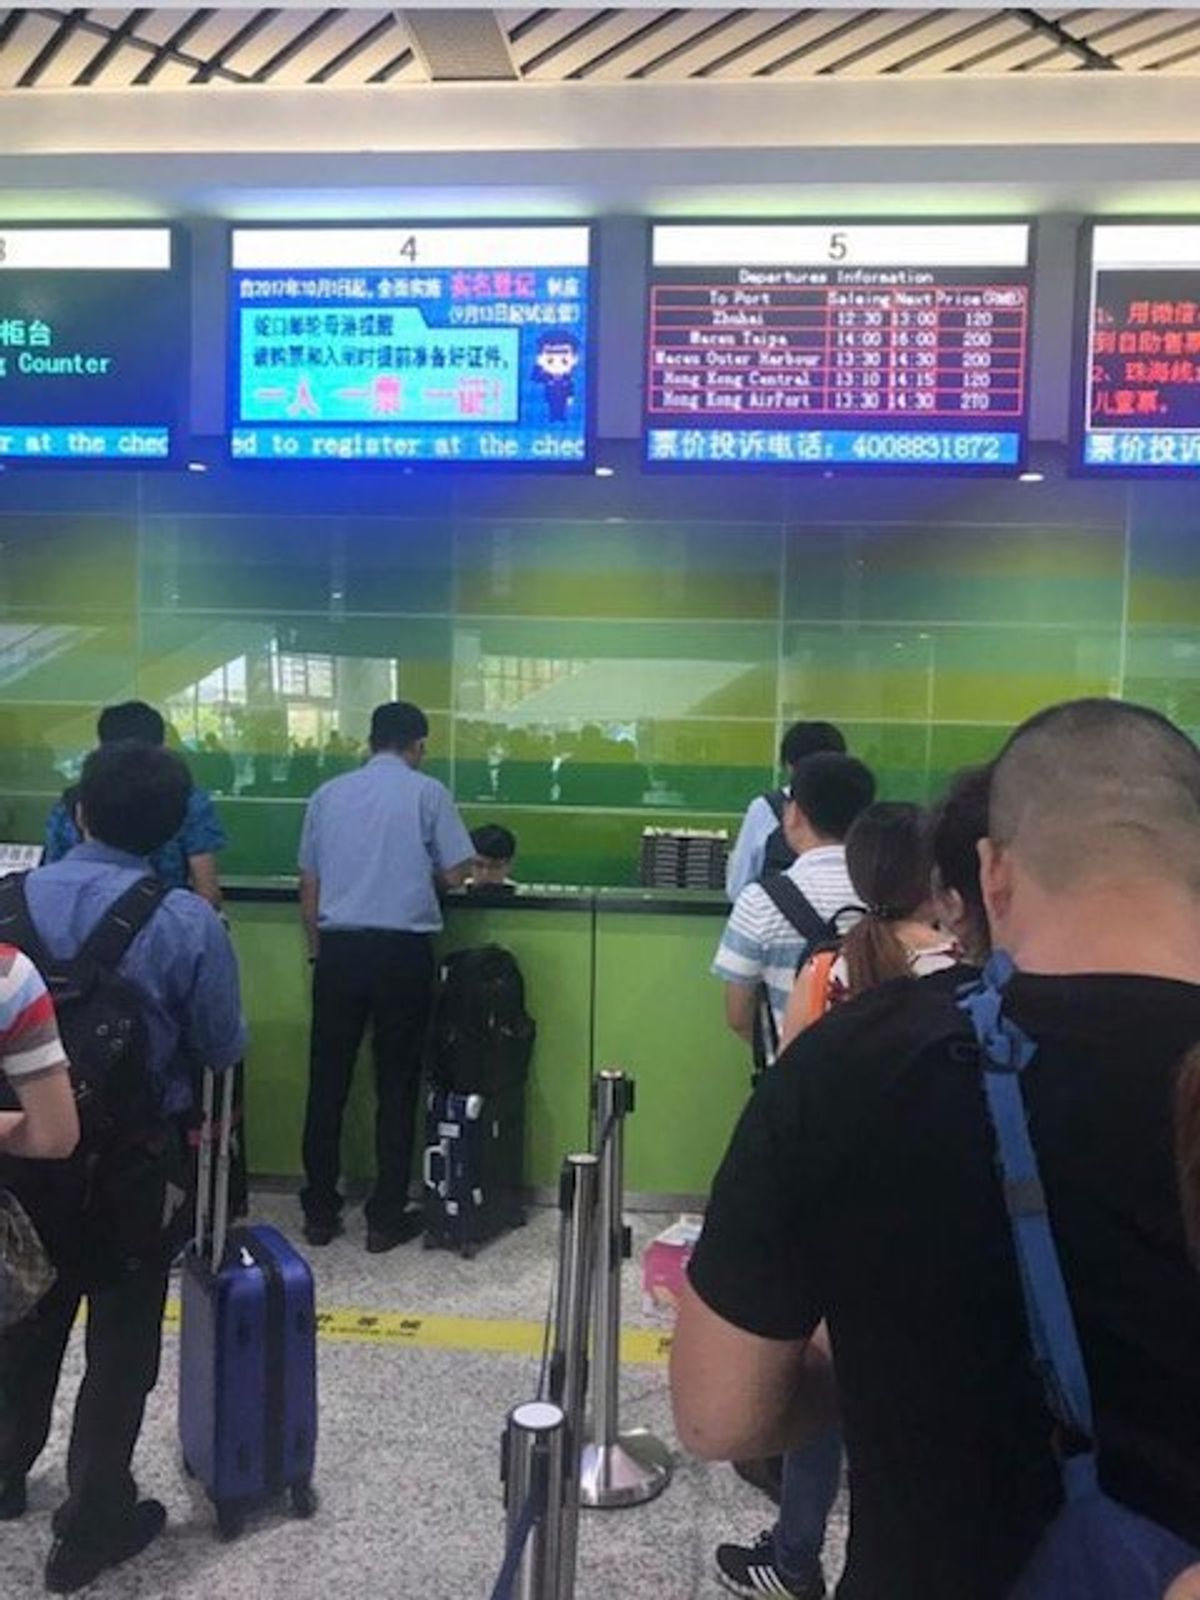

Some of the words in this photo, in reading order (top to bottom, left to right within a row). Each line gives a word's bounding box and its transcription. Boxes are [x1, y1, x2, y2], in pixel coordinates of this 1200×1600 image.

[400, 236, 417, 261] 4
[827, 234, 848, 260] 5
[738, 269, 828, 284] Departures
[836, 269, 934, 284] Information
[964, 313, 993, 327] 120
[962, 333, 992, 347] 200
[18, 352, 111, 374] Counter
[962, 353, 991, 367] 200
[748, 371, 811, 387] Central
[963, 374, 991, 387] 120
[960, 394, 990, 409] 270
[67, 431, 106, 453] the
[271, 432, 299, 454] to
[312, 431, 421, 458] register
[434, 435, 462, 456] at
[480, 431, 519, 458] the
[853, 433, 1000, 461] 4008831872
